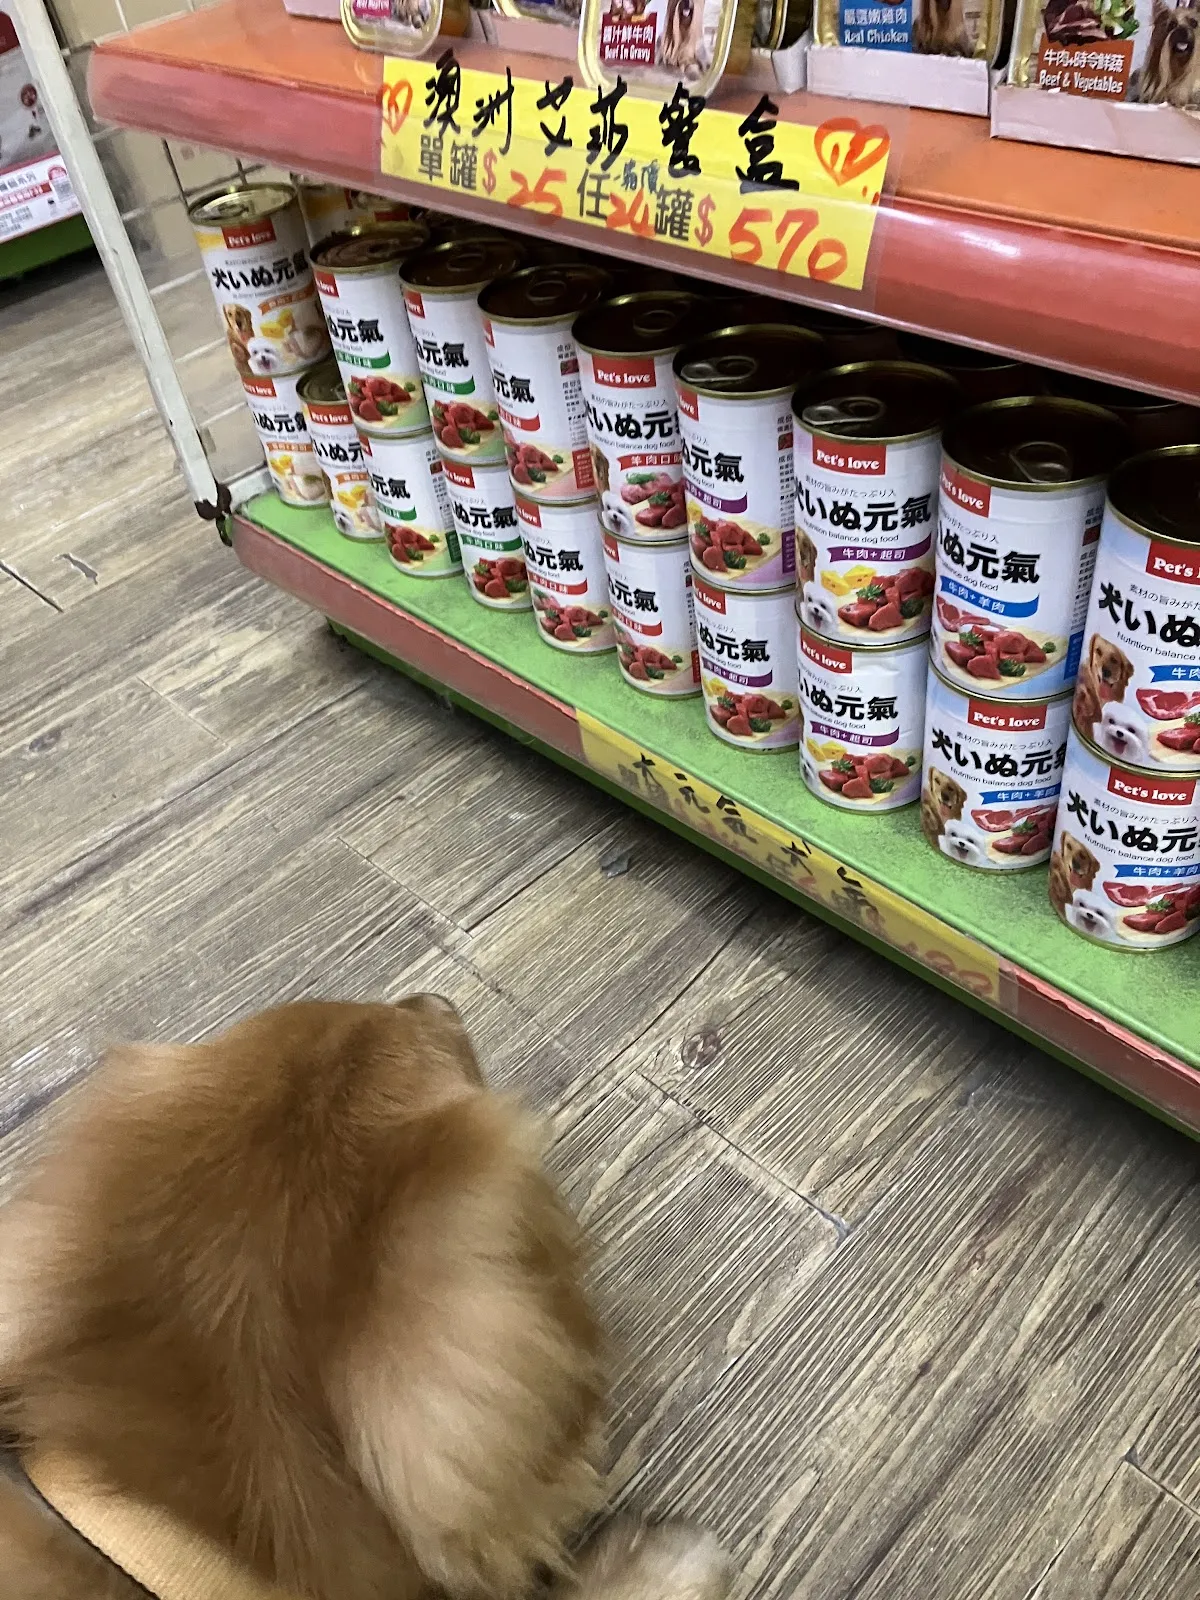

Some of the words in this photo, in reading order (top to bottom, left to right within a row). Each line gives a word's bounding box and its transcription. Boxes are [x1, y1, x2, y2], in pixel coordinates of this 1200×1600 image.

[844, 29, 865, 44] Real
[867, 28, 909, 44] Chicken
[620, 44, 629, 60] In
[630, 45, 651, 62] Gravy
[1039, 70, 1061, 87] Beef
[1062, 76, 1071, 88] &
[1074, 71, 1124, 94] Vegetables
[492, 369, 535, 403] 元氣
[597, 369, 621, 384] Pet's
[623, 373, 651, 384] love
[586, 401, 680, 440] いぬ元
[659, 440, 676, 448] food
[816, 449, 845, 467] Pet's
[847, 456, 880, 470] love
[370, 473, 411, 499] 元氣
[958, 488, 984, 510] love
[828, 530, 860, 543] balance
[861, 536, 878, 545] dog
[880, 534, 899, 543] food
[842, 548, 906, 561] 牛肉+起司
[1153, 557, 1194, 578] Pet's
[963, 575, 978, 588] dog
[980, 580, 999, 592] food
[703, 592, 722, 610] love
[948, 582, 1005, 614] 牛肉+羊肉
[1116, 630, 1153, 652] Nutrition
[1154, 647, 1196, 662] balance
[822, 654, 847, 670] love
[834, 719, 848, 729] dog
[849, 721, 866, 729] food
[973, 711, 1005, 727] Pet's
[1009, 716, 1041, 727] love
[820, 725, 873, 746] 牛肉+起司
[950, 766, 981, 783] Nutrition
[982, 777, 1016, 788] balance
[1017, 777, 1034, 788] dog
[1035, 775, 1052, 786] food
[1113, 779, 1149, 798] Pet's
[1151, 789, 1187, 801] love
[1066, 789, 1200, 854] 犬いぬ元
[1084, 833, 1116, 854] Nutrition
[1117, 850, 1154, 863] balance
[1156, 855, 1173, 864] dog
[1174, 853, 1195, 862] food
[1132, 866, 1199, 876] 牛肉+羊肉
